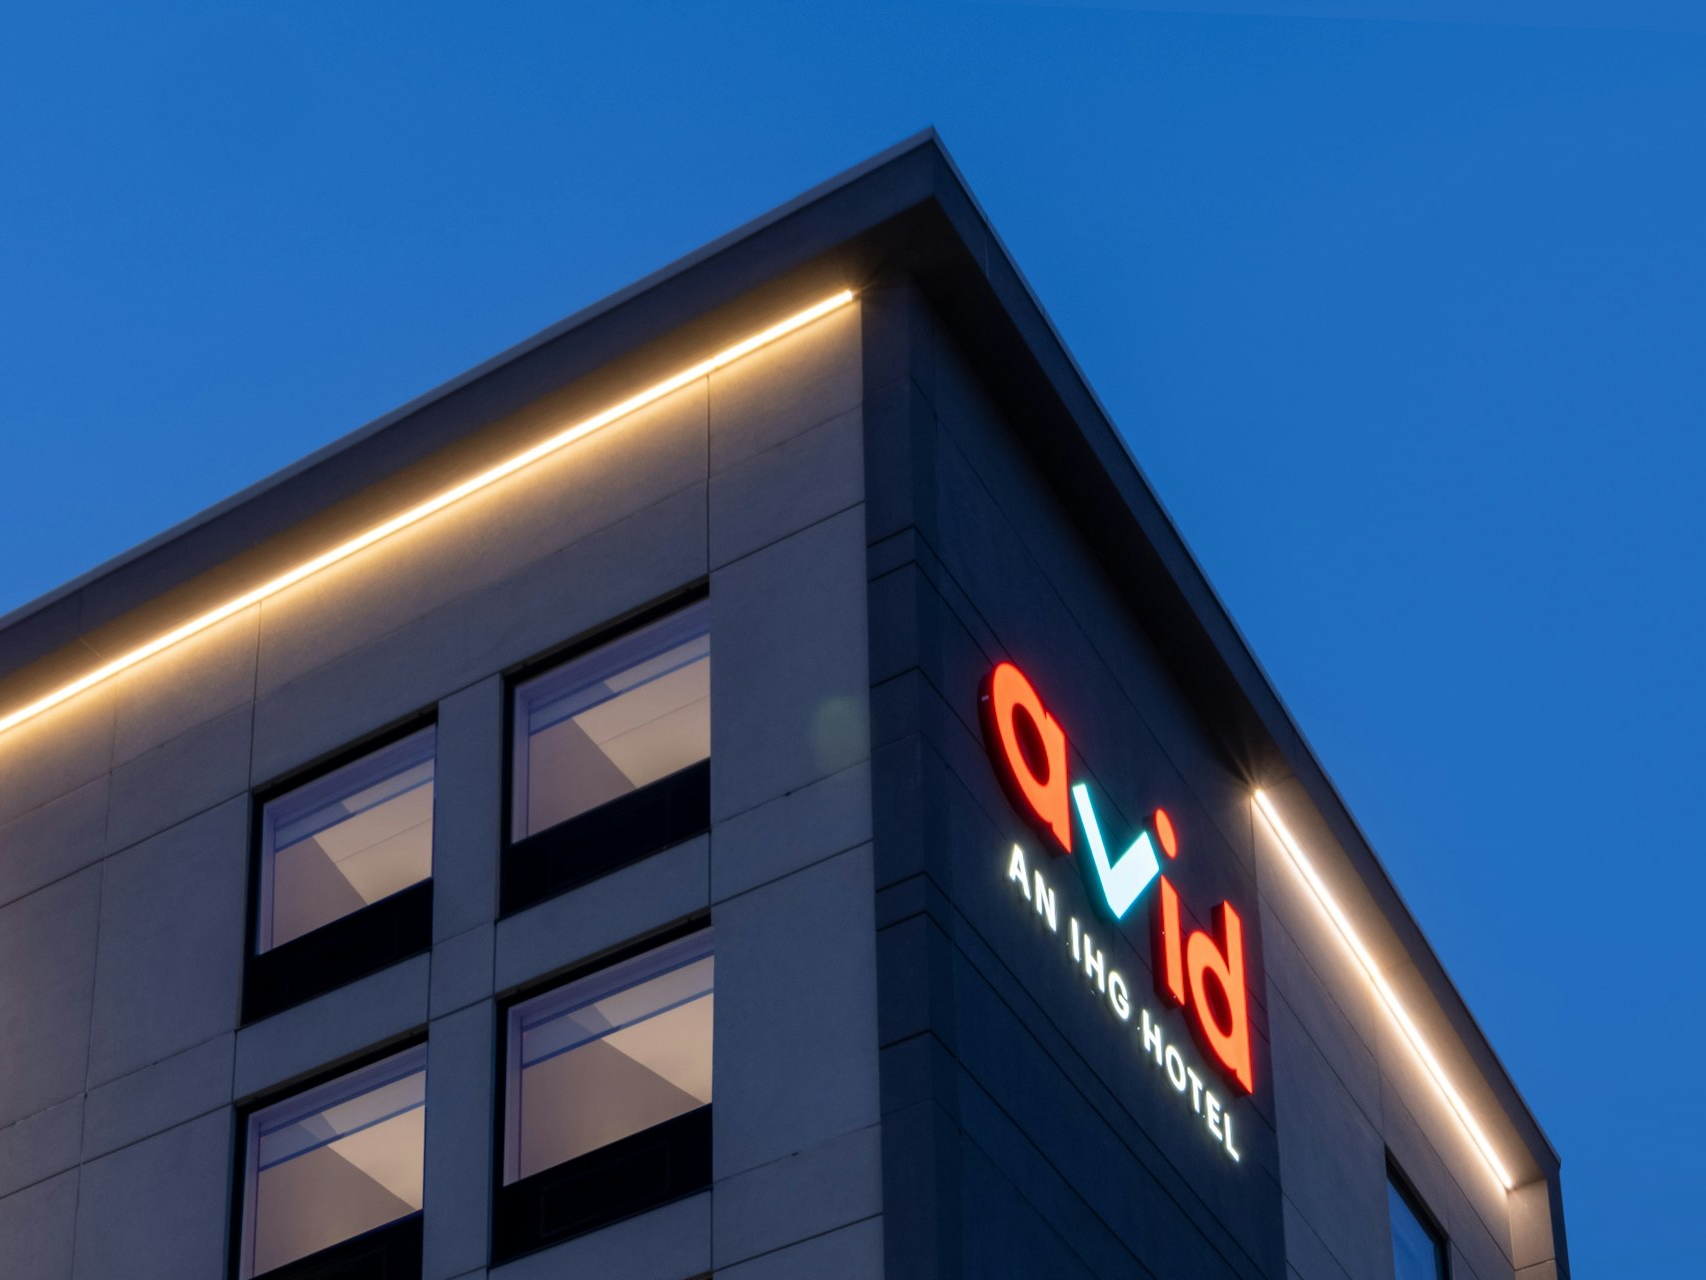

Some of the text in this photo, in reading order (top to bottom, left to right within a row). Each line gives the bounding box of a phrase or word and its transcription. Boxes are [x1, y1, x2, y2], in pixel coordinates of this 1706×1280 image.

[989, 661, 1254, 1095] avid
[1007, 843, 1241, 1163] AN IHG HOTEL
